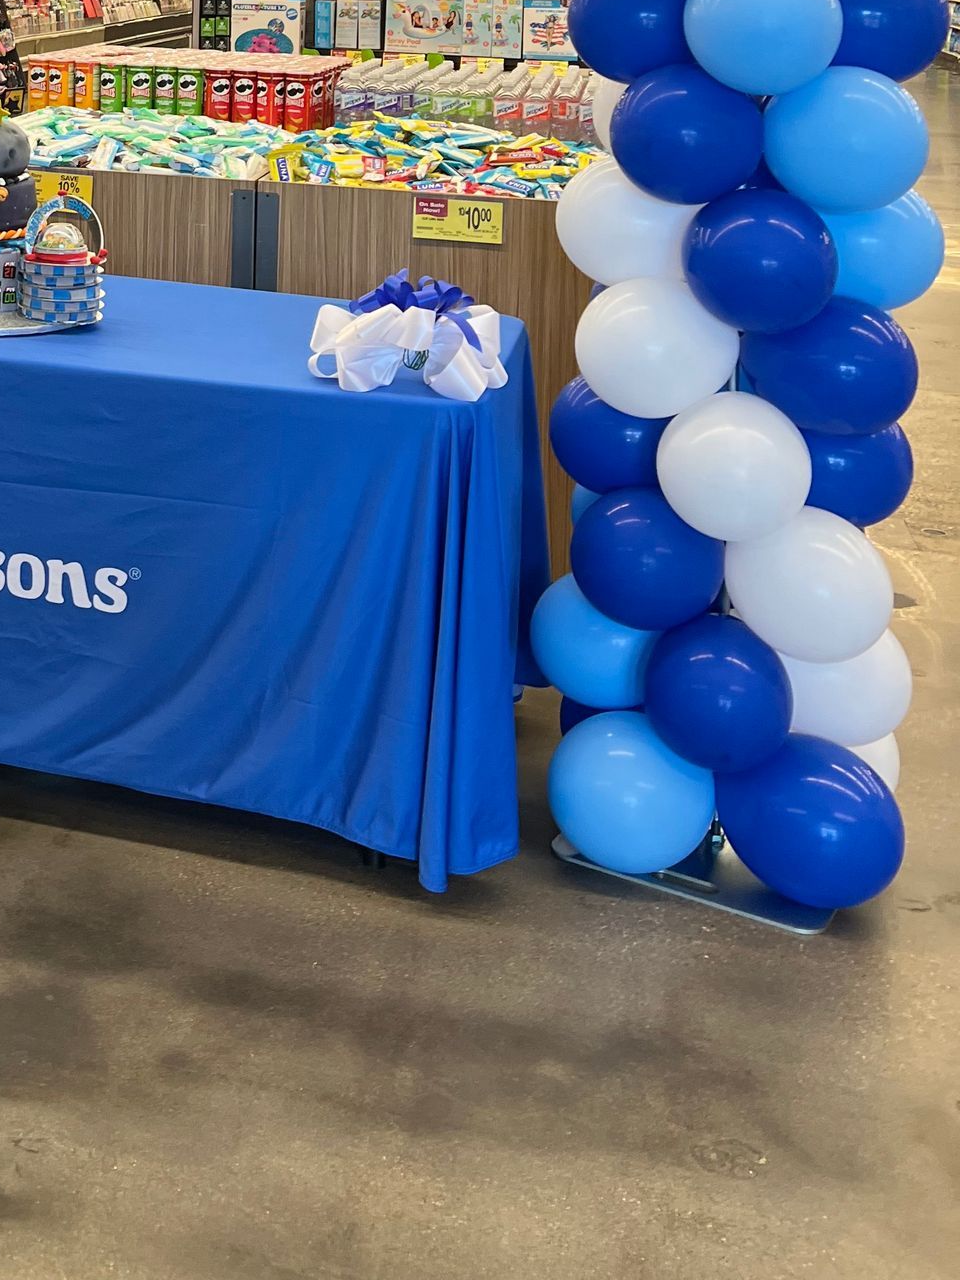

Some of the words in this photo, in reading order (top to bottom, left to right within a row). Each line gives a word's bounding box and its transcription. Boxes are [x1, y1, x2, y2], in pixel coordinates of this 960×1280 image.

[496, 104, 515, 115] propel
[526, 106, 545, 117] propel
[277, 158, 287, 181] LUNA
[58, 181, 80, 193] 10%
[4, 293, 16, 303] 00
